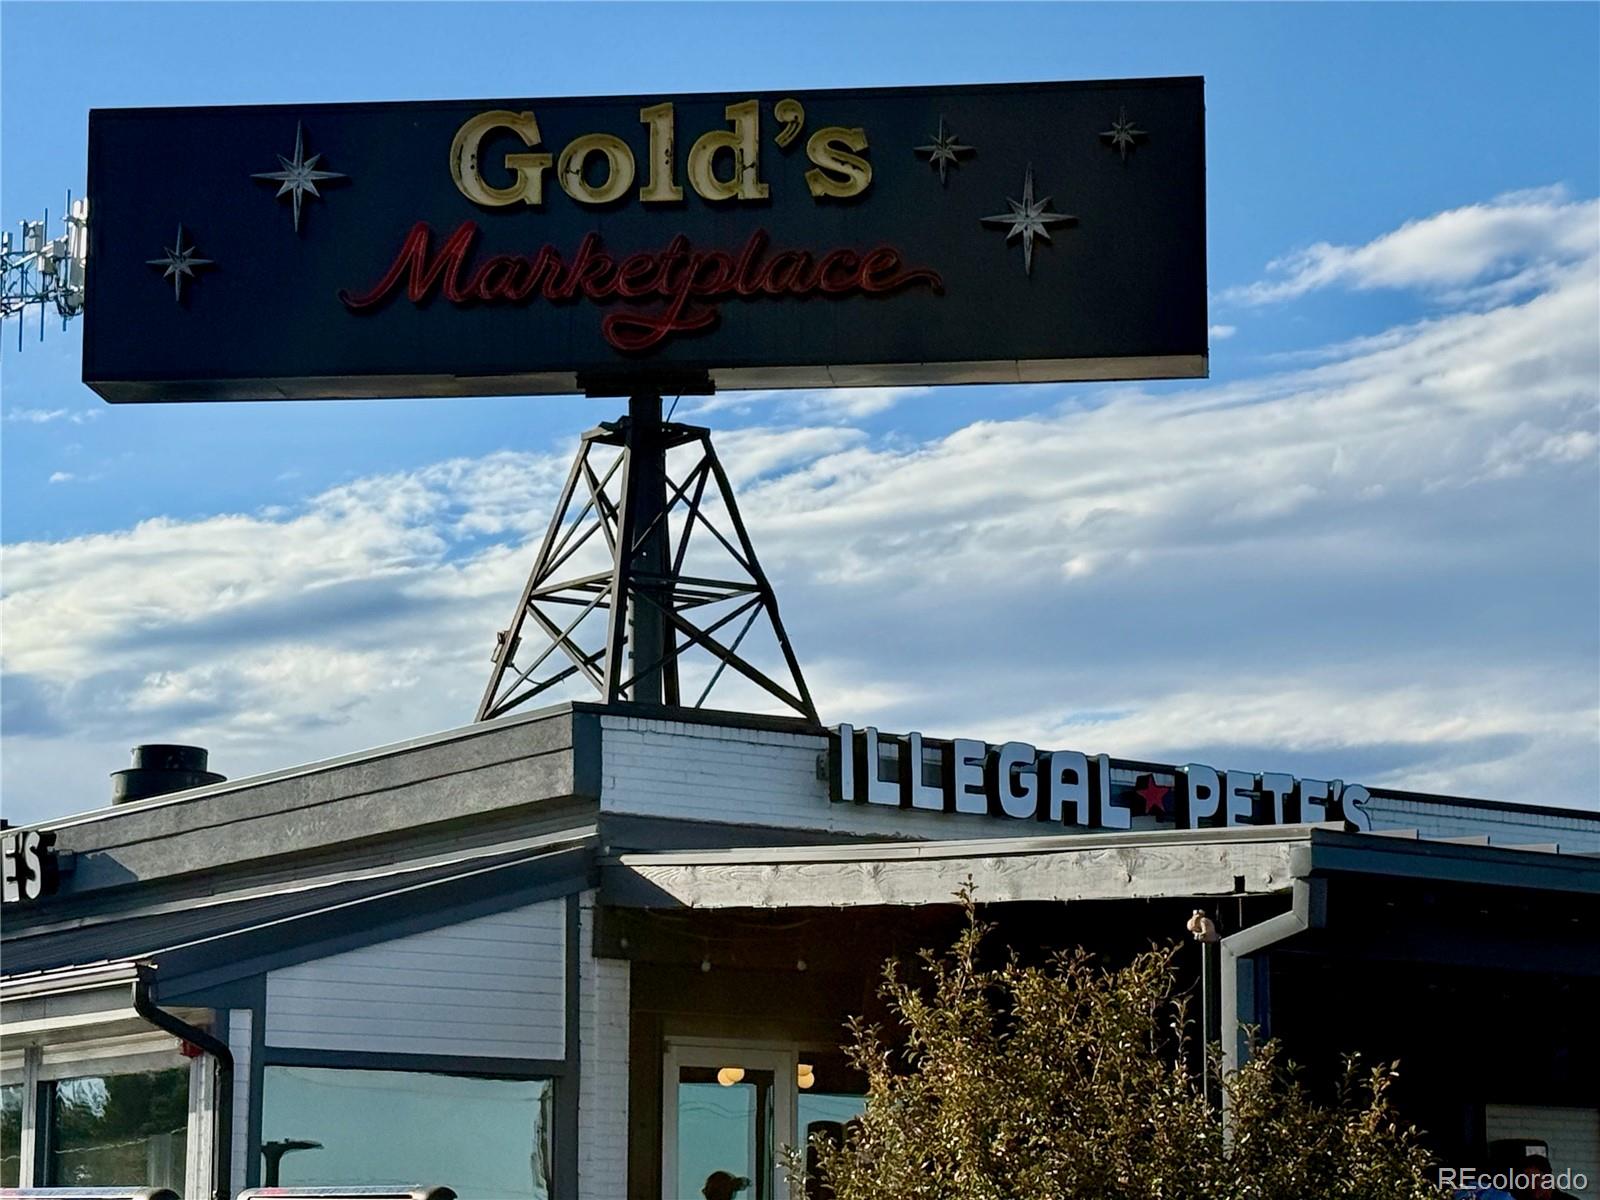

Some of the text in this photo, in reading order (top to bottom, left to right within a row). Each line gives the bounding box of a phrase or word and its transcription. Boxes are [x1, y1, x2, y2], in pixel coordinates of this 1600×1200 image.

[449, 98, 874, 208] Gold's
[339, 220, 945, 353] Marketplace
[838, 723, 1132, 830] ILLEGAL
